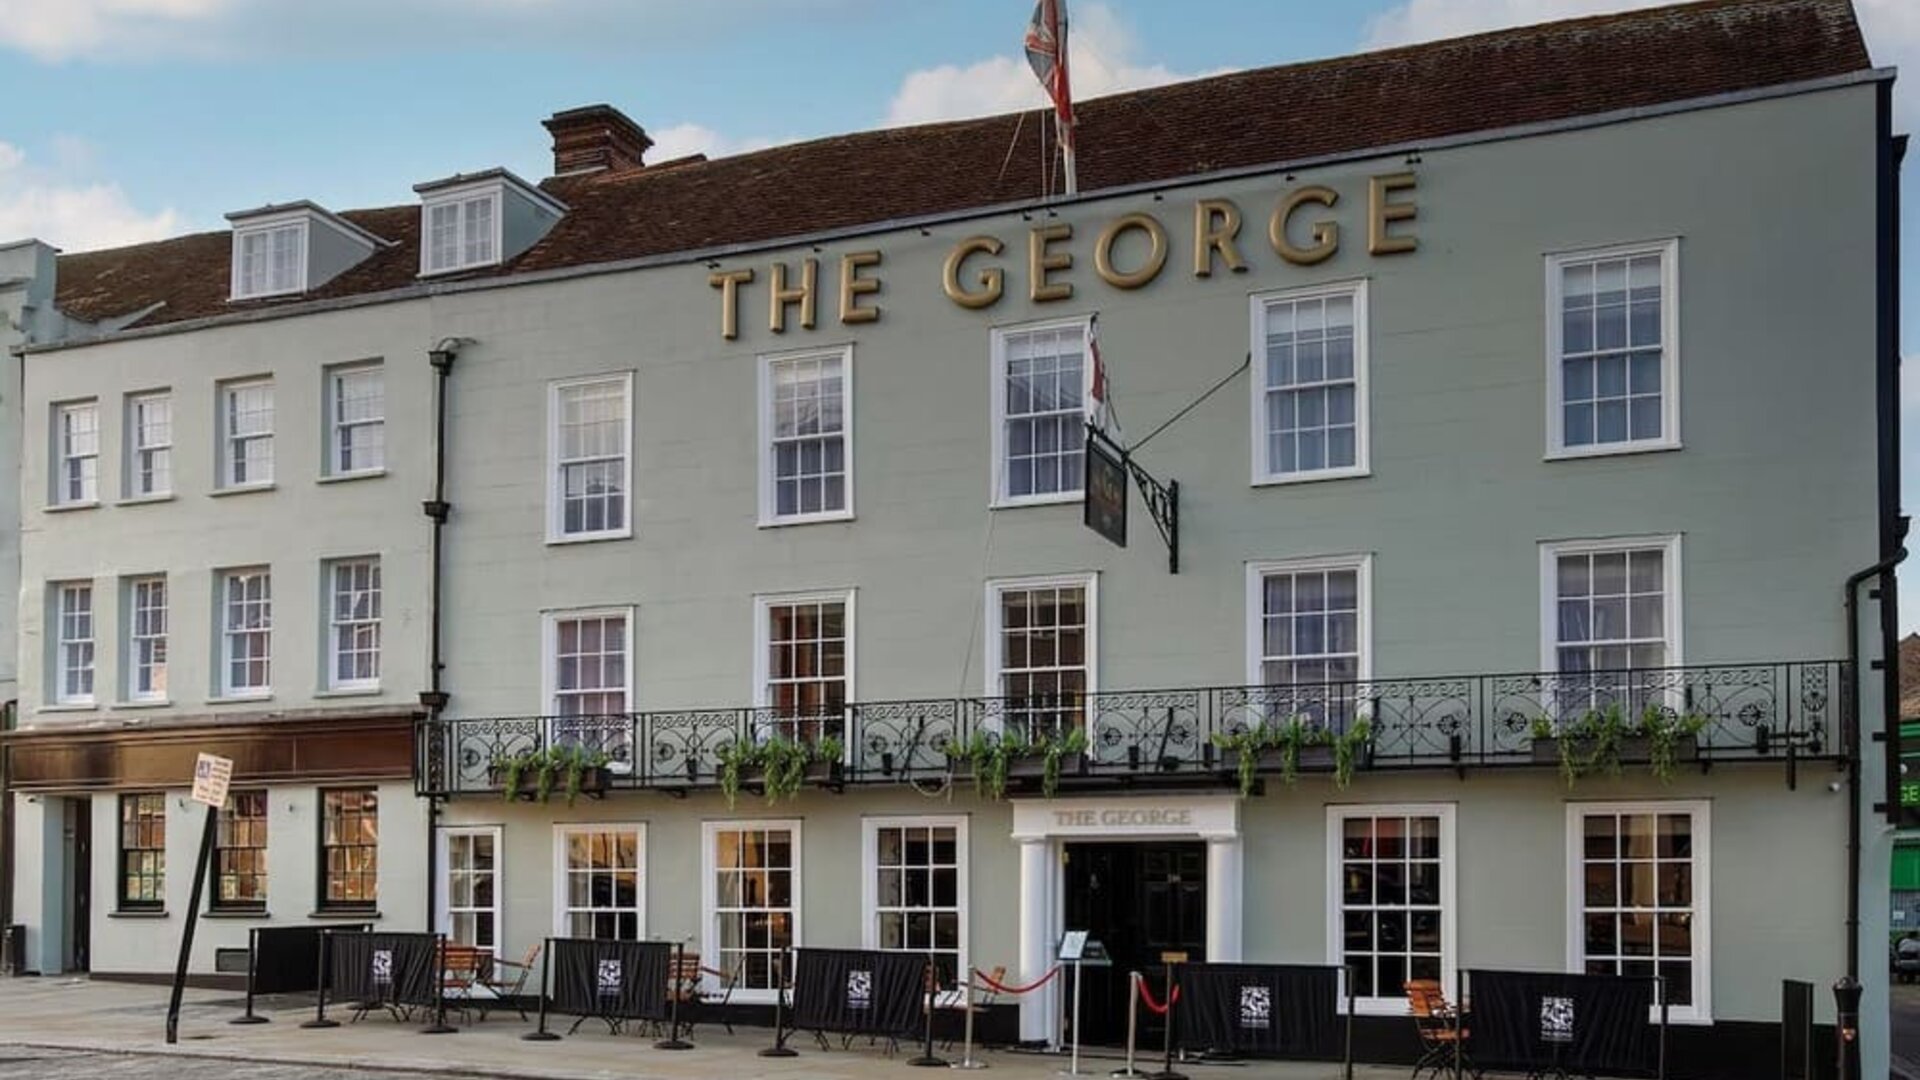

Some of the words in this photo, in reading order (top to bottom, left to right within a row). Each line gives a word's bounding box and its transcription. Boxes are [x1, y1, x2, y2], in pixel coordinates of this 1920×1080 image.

[709, 250, 881, 340] THE
[943, 171, 1417, 309] GEORGE
[1054, 809, 1097, 826] THE
[1102, 808, 1191, 826] GEORGE
